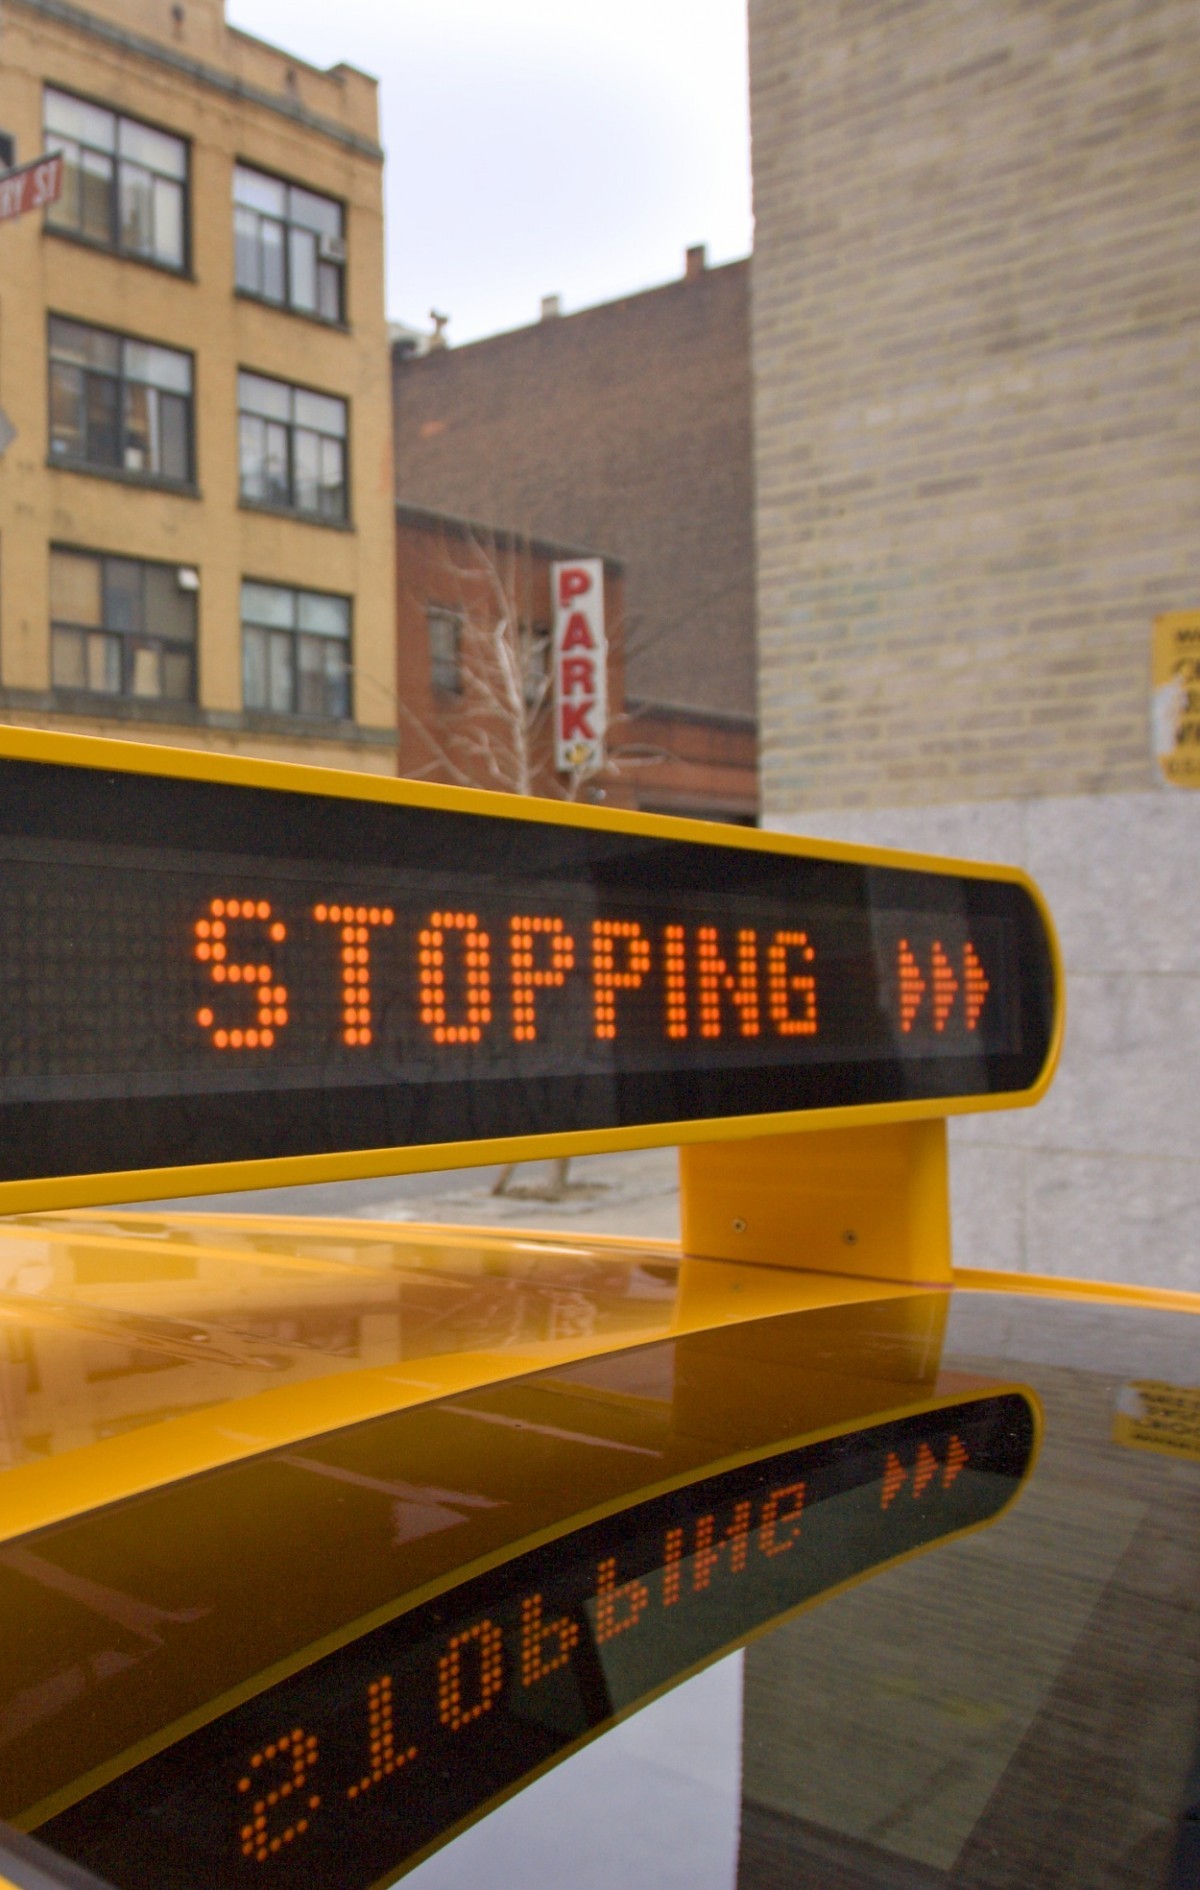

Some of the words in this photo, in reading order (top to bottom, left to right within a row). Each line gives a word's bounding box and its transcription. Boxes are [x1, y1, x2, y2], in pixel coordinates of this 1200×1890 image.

[33, 163, 59, 208] ST
[558, 567, 597, 742] PARK
[194, 897, 818, 1049] STOPPING
